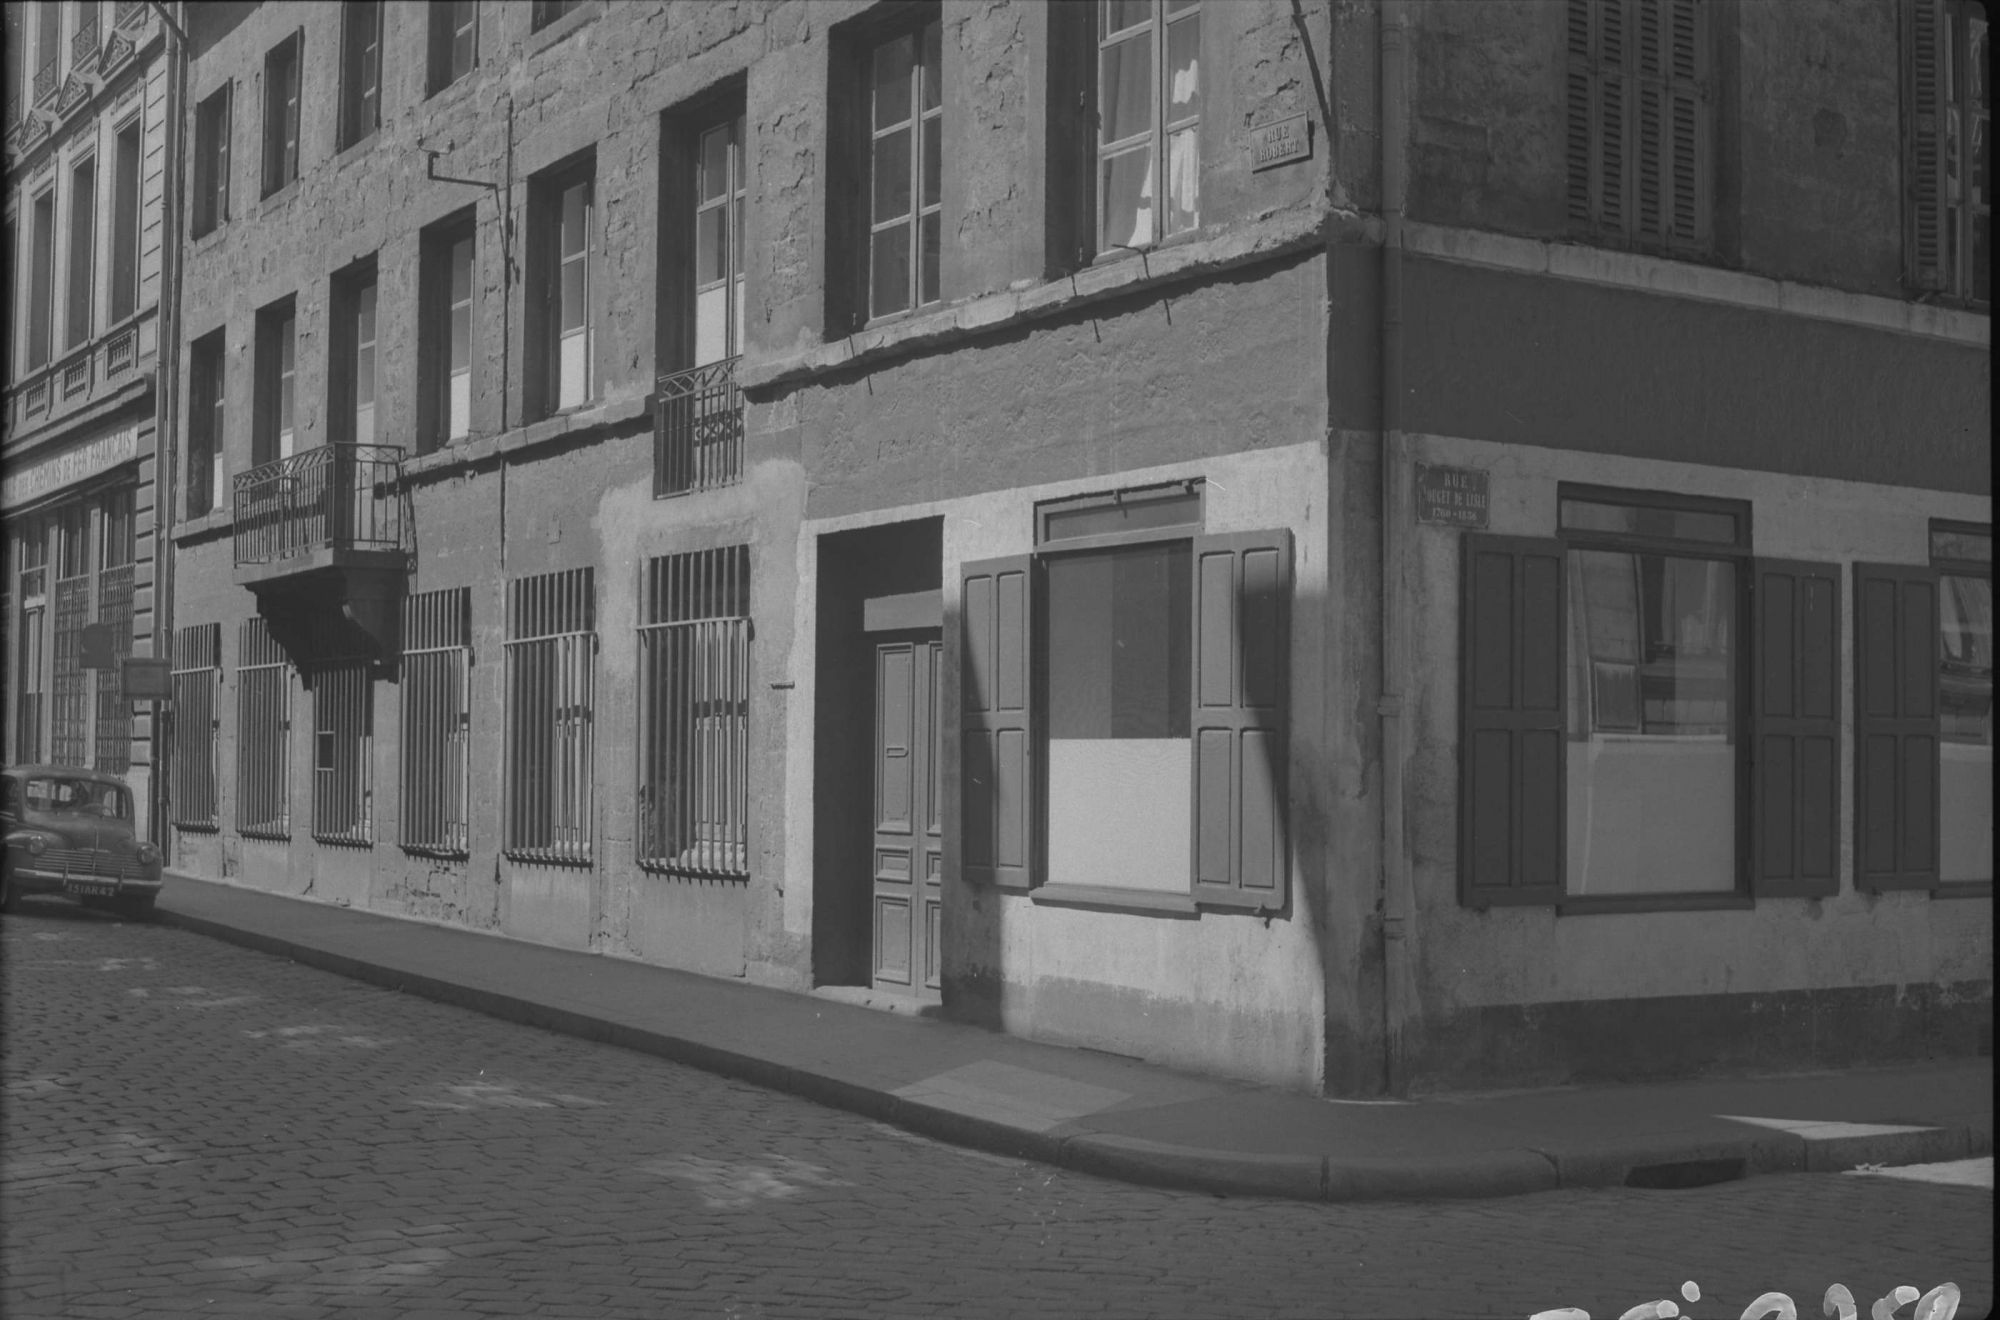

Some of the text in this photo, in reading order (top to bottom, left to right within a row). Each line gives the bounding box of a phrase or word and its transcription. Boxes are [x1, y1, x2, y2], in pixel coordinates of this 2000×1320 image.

[1268, 125, 1289, 143] RUE
[1260, 136, 1299, 162] ROBERT
[1444, 472, 1467, 488] RUE
